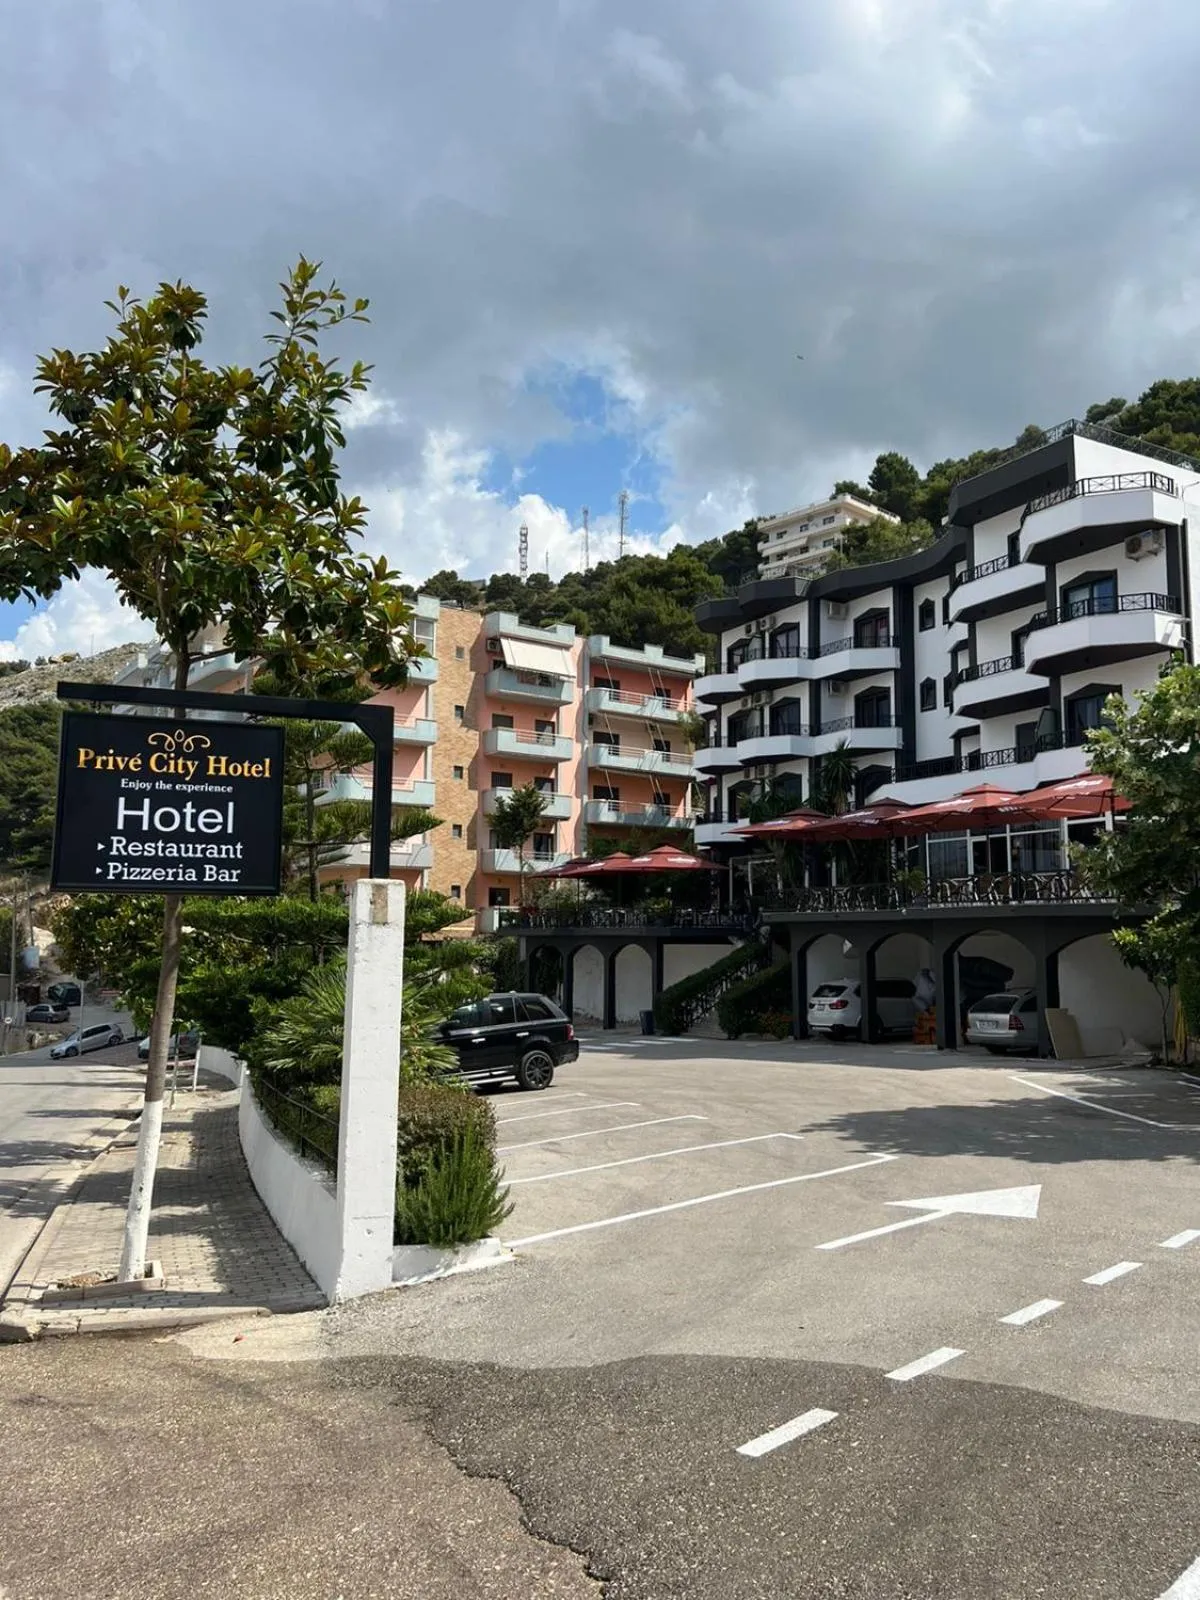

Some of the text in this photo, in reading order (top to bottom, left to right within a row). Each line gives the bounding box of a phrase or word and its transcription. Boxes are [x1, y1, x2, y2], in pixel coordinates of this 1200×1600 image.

[78, 748, 271, 781] Privé City Hotel
[120, 778, 233, 793] Enjoy the experience
[116, 796, 235, 834] Hotel
[109, 835, 243, 859] Restaurant
[106, 862, 242, 882] Pizzeria Bar
